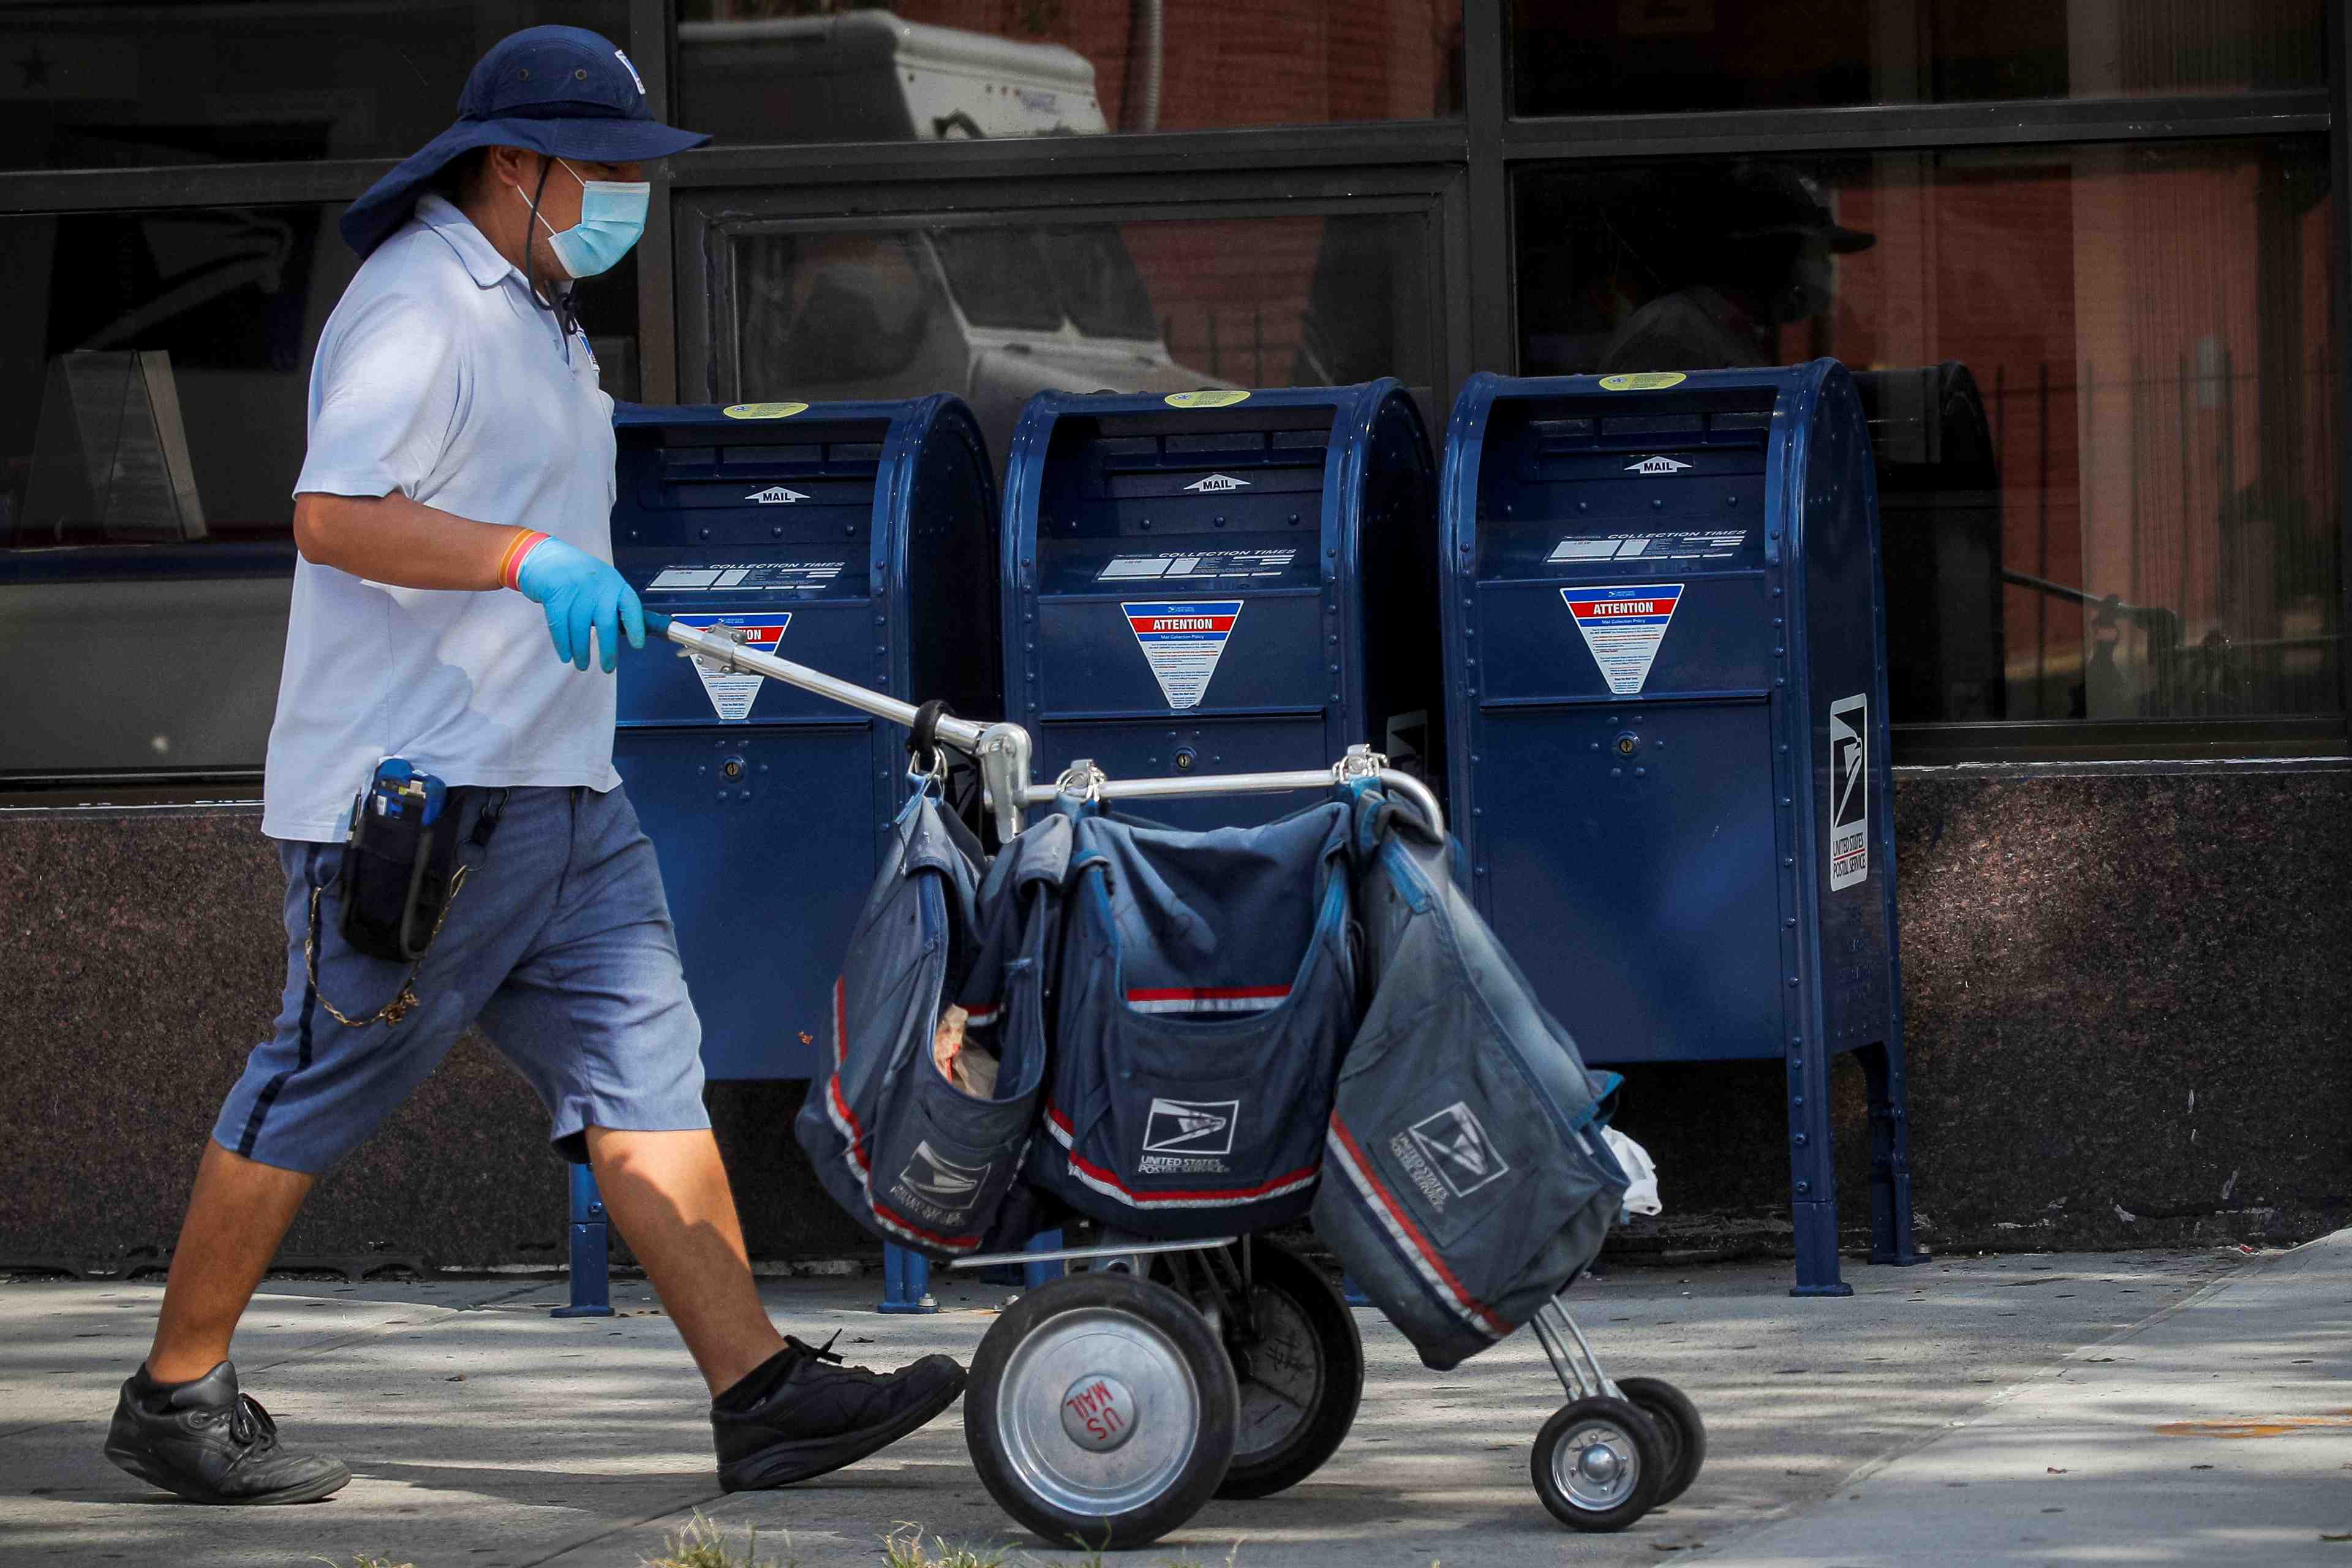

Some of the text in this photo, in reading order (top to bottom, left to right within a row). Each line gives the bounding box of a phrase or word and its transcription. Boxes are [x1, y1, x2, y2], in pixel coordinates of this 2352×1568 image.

[1643, 462, 1673, 471] MAIL
[1203, 480, 1232, 489] MAIL
[763, 492, 791, 501] MAIL
[1607, 531, 1700, 540] COLLECTION
[1593, 601, 1653, 615] ATTENTION
[1153, 619, 1213, 630] ATTENTION
[1833, 832, 1863, 856] UNITED STATES
[1833, 853, 1866, 879] POSTAL SERVICE
[1141, 1155, 1221, 1166] UNITED STATES
[1138, 1164, 1177, 1174] POSTAL
[1066, 1381, 1114, 1422] MAIL
[1087, 1407, 1125, 1441] US
